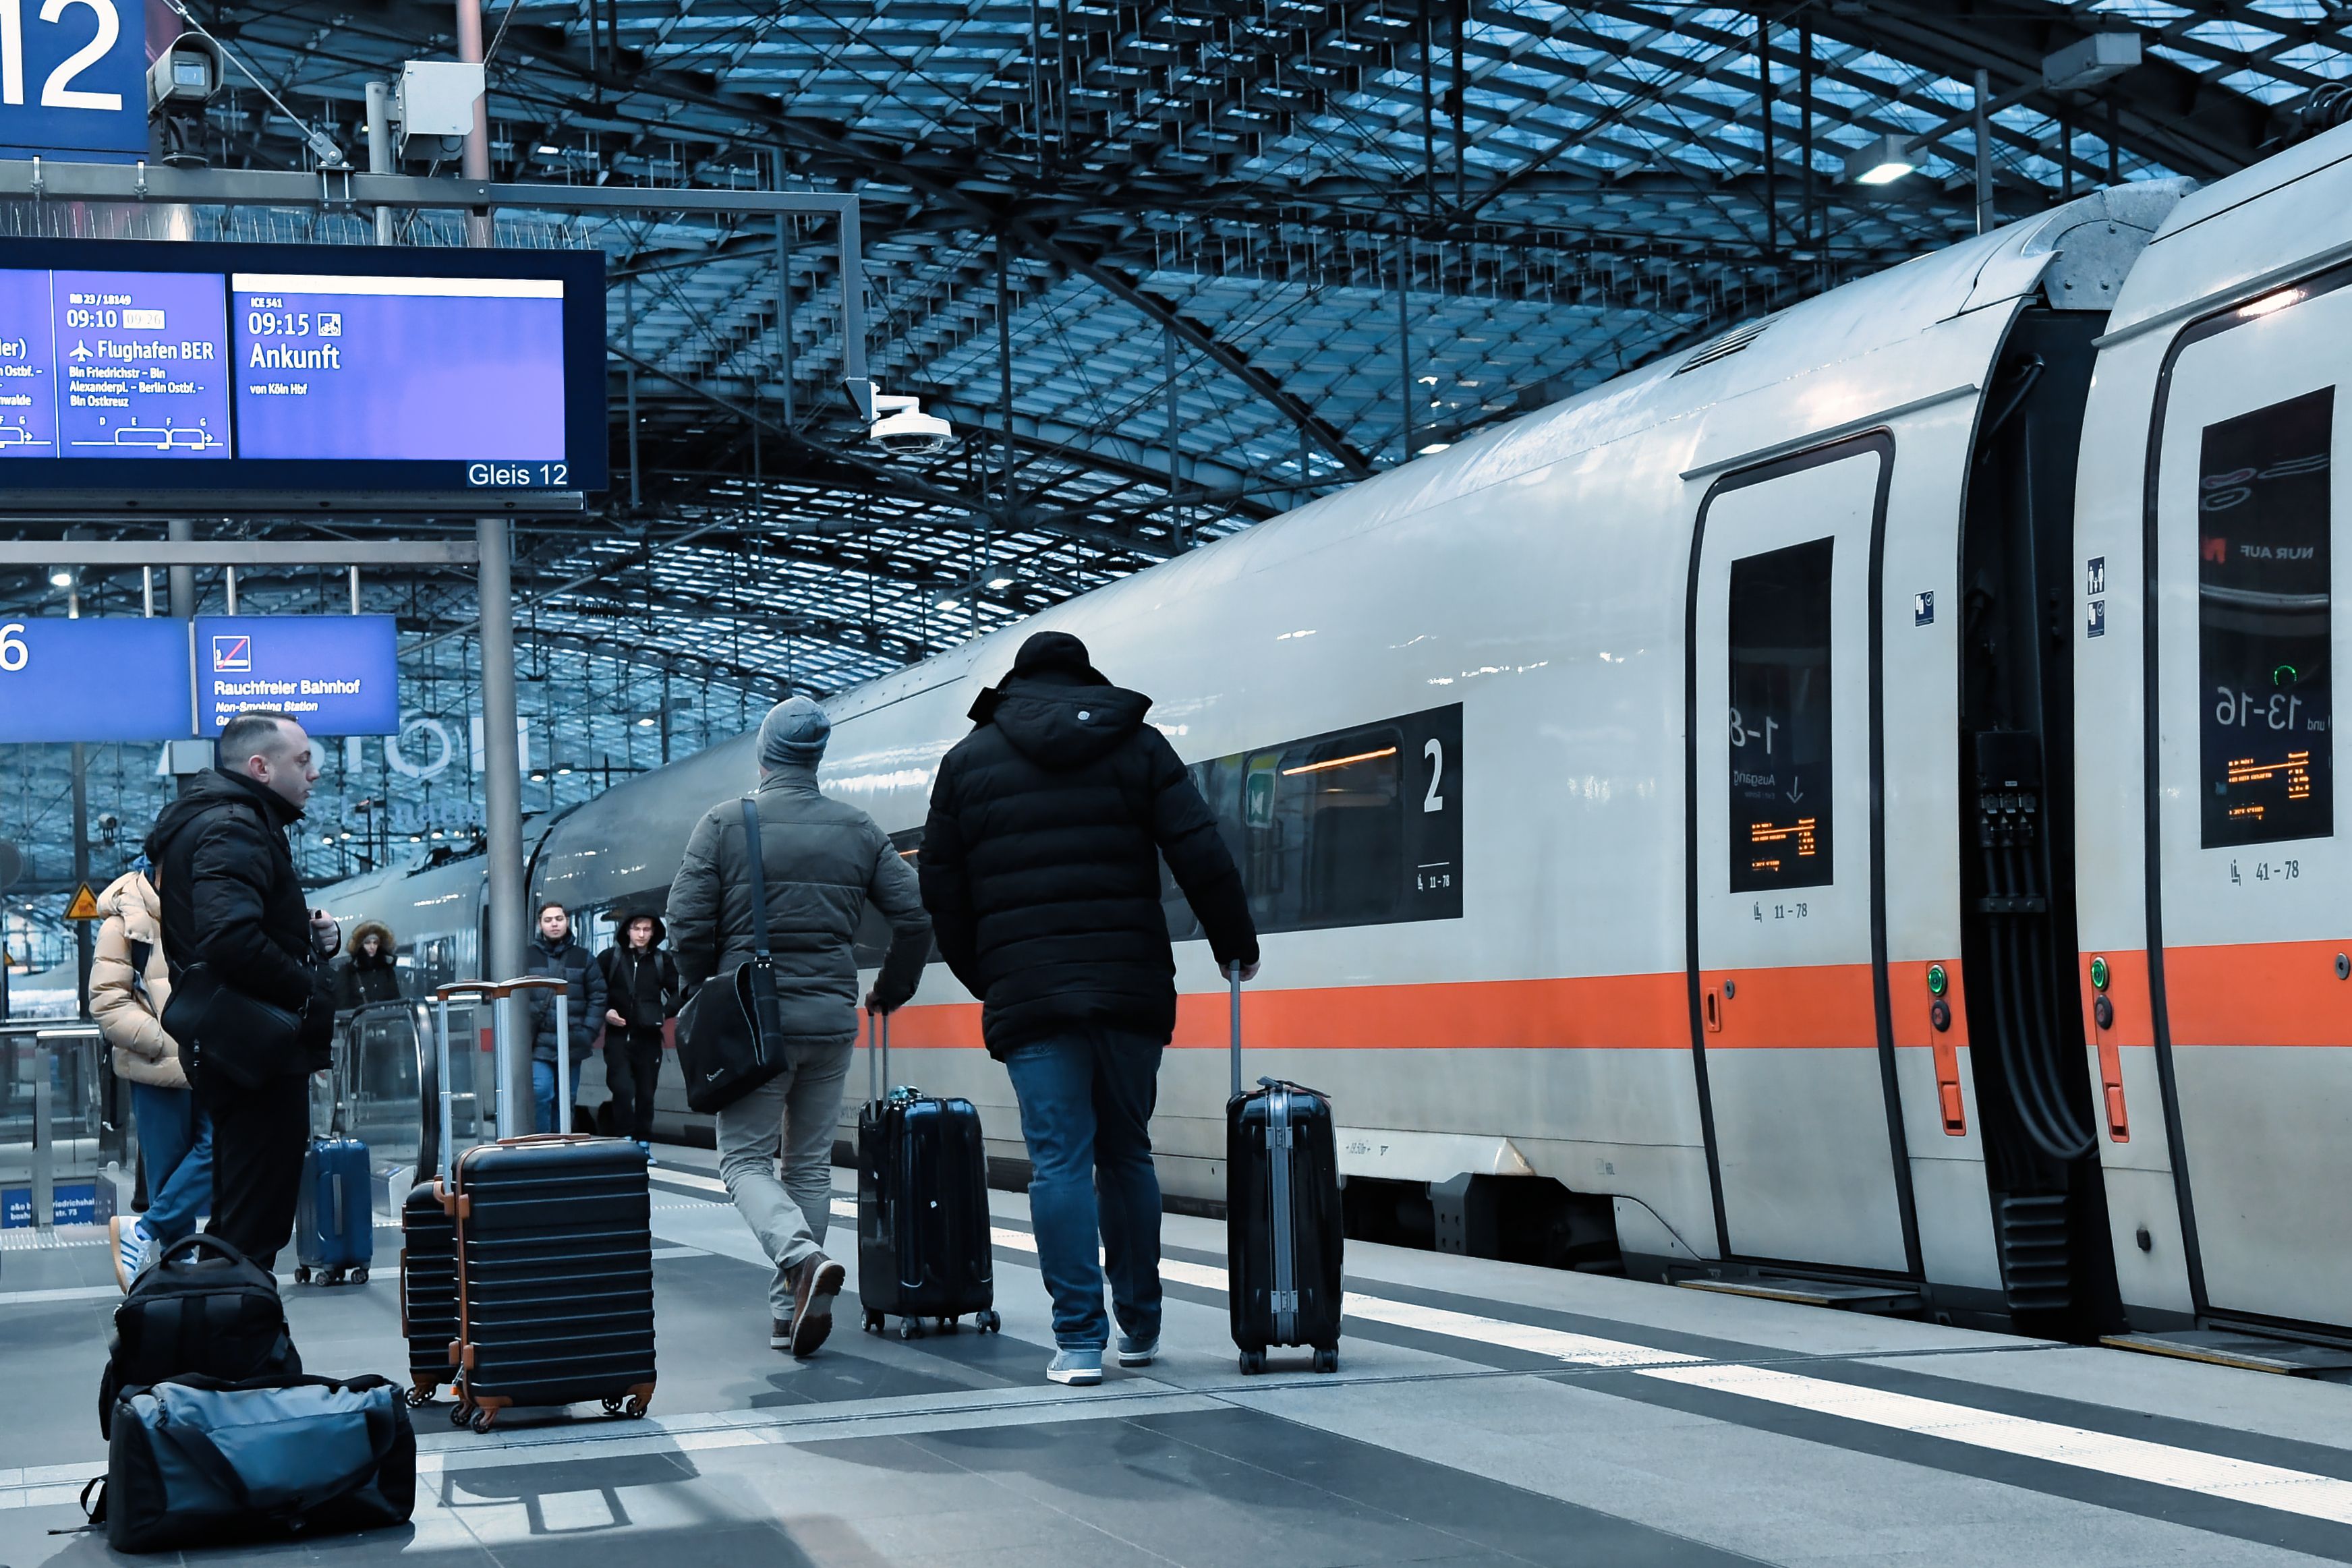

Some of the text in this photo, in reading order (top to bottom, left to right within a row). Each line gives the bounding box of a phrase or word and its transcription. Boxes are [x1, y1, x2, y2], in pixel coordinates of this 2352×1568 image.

[0, 0, 122, 111] 12
[84, 294, 96, 304] 23
[250, 297, 283, 308] ICE 541
[67, 309, 117, 328] 09:10
[248, 312, 310, 336] 09:15
[0, 338, 26, 360] er)
[98, 340, 214, 363] Flughafen BER
[250, 342, 341, 370] Ankunft
[5, 365, 34, 377] Ostbf.
[69, 366, 85, 378] Bln
[86, 366, 140, 378] Friedrichstr
[150, 367, 166, 379] Bln
[69, 380, 129, 395] Alexanderpl.
[138, 381, 167, 393] Berlin
[168, 382, 196, 393] Ostbf.
[250, 383, 308, 395] von Köln Hbf
[70, 395, 130, 407] Bln Ostkreuz
[99, 417, 206, 427] D E F G
[469, 463, 567, 486] Gleis 12
[0, 623, 28, 671] 6
[214, 679, 361, 695] Rauchfreier Bahnhof
[283, 701, 318, 712] Station
[1424, 738, 1443, 813] 2
[2256, 863, 2270, 881] 41
[2285, 860, 2299, 880] 78
[1430, 876, 1436, 888] 11
[1442, 874, 1450, 888] 78
[1775, 904, 1784, 919] 11
[1796, 902, 1808, 919] 78
